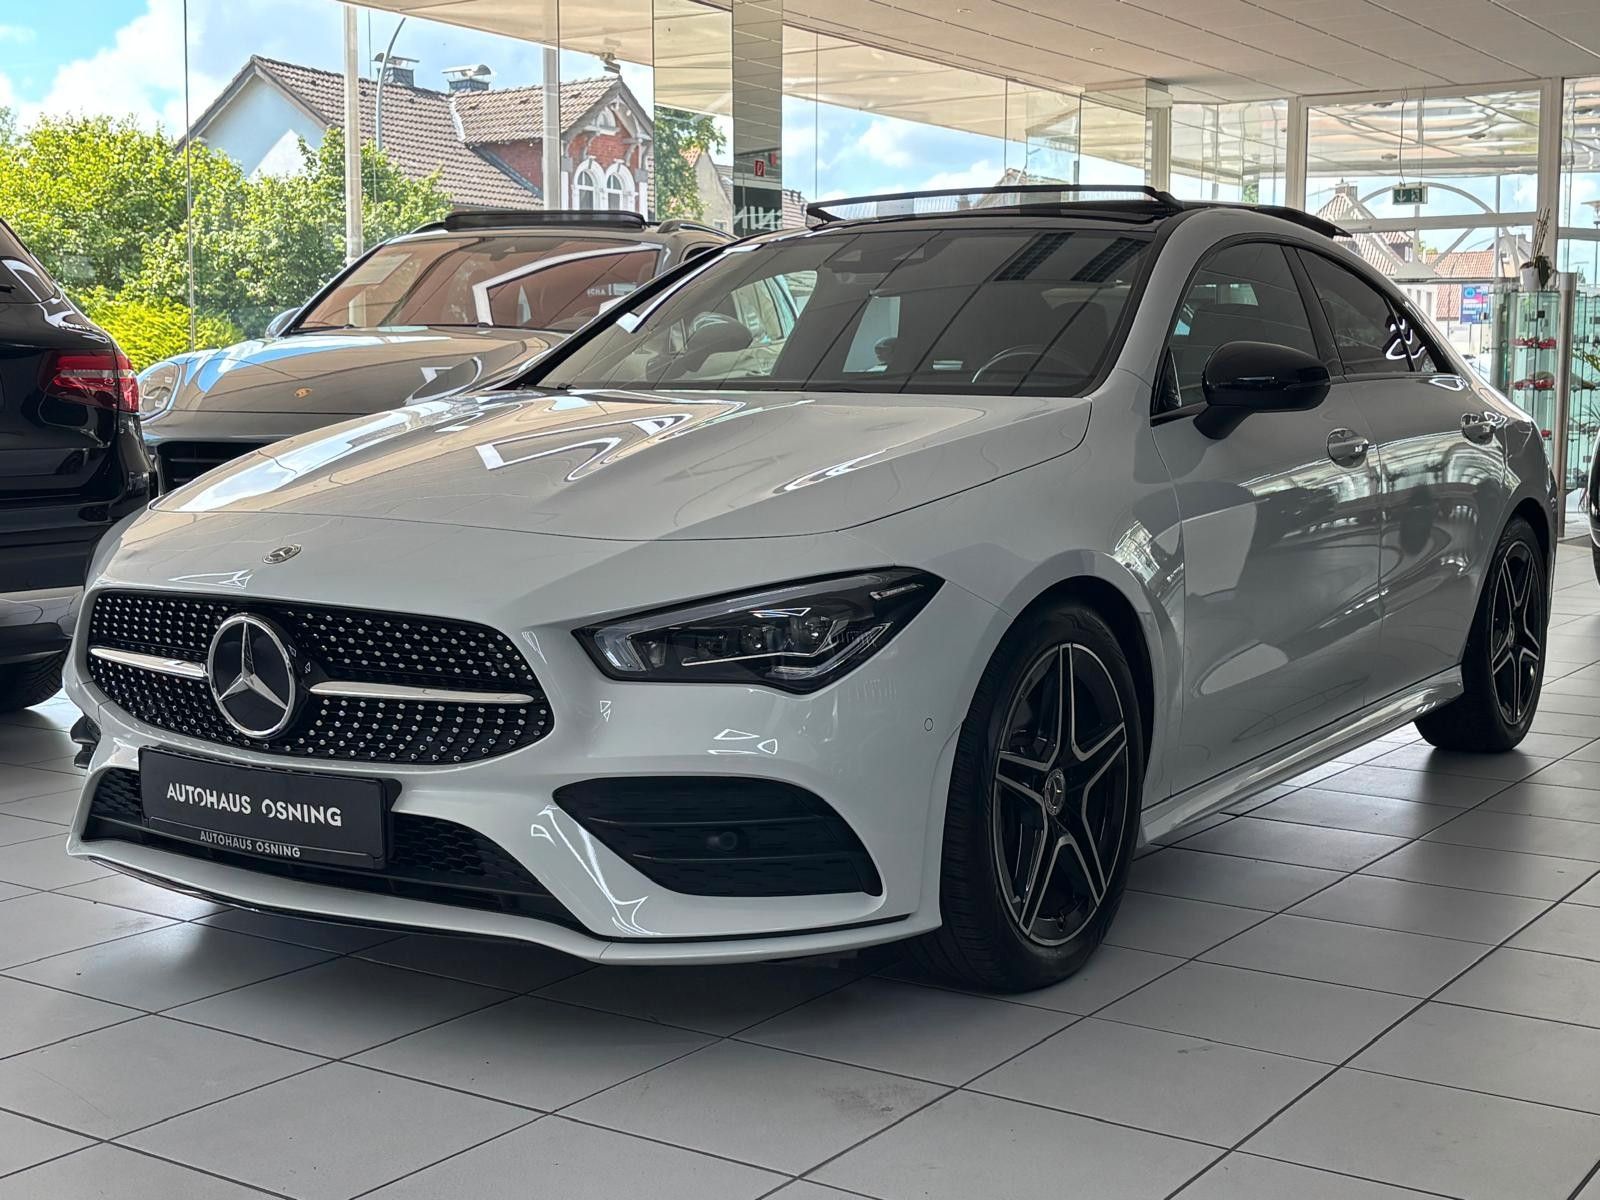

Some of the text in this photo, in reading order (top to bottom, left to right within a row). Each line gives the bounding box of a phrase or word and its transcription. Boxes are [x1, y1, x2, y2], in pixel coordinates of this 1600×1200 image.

[167, 783, 342, 827] AUTOHAUS OSNING
[200, 831, 301, 858] AUTOHAUS OSNING
